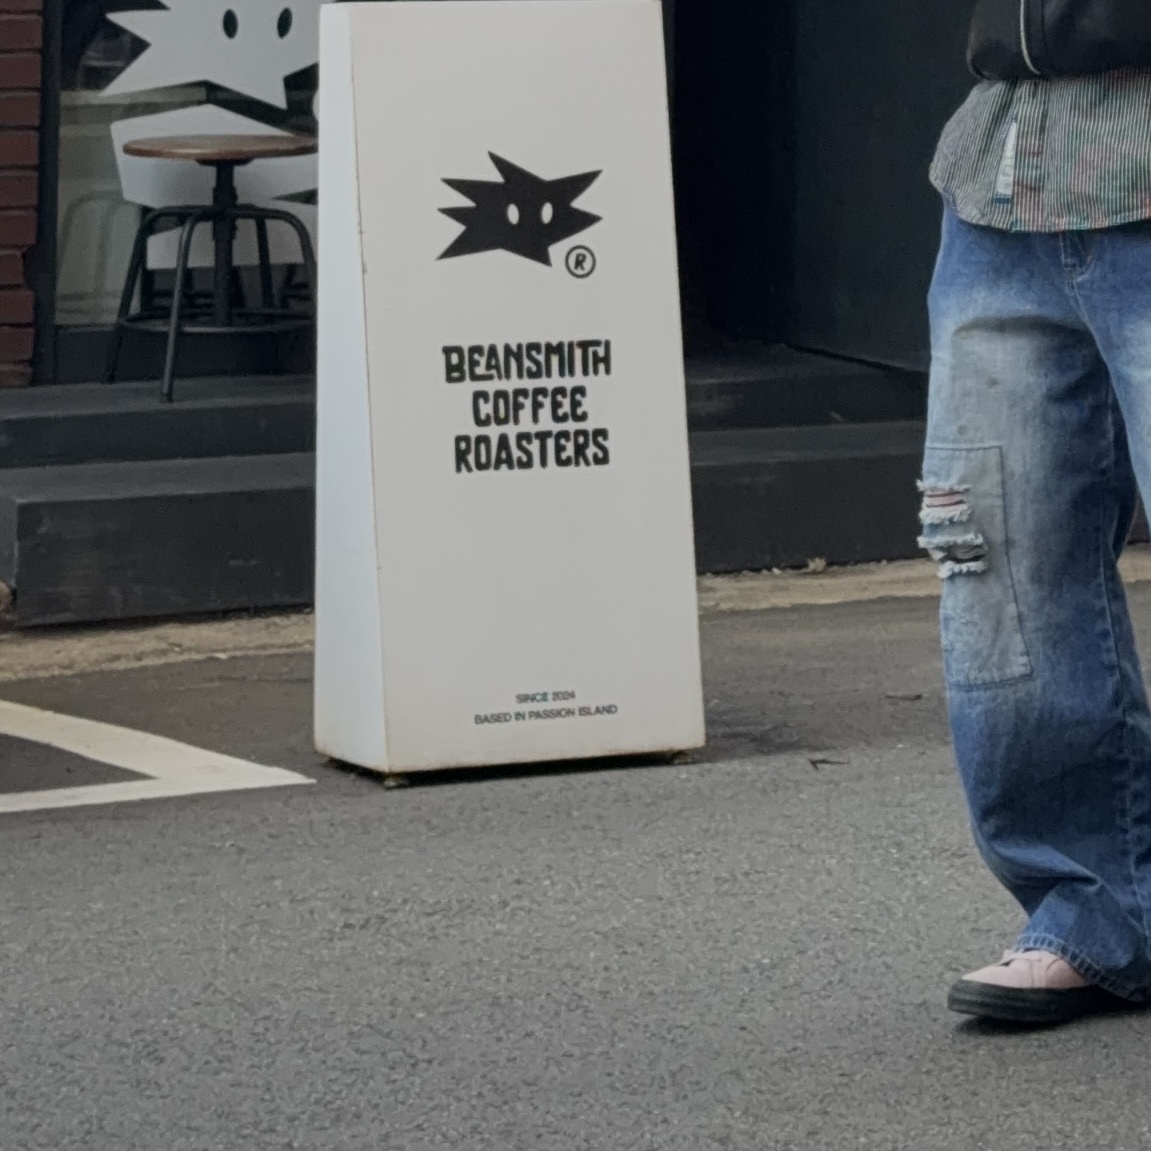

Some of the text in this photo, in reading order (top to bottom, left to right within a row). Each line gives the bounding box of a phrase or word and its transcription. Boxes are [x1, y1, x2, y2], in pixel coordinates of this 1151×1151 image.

[442, 339, 612, 384] BEANSMITH
[472, 385, 589, 427] COFFEE
[454, 428, 611, 473] ROASTERS
[474, 704, 618, 725] BASED IN PASSION ISLAND
[515, 691, 549, 704] SINCE
